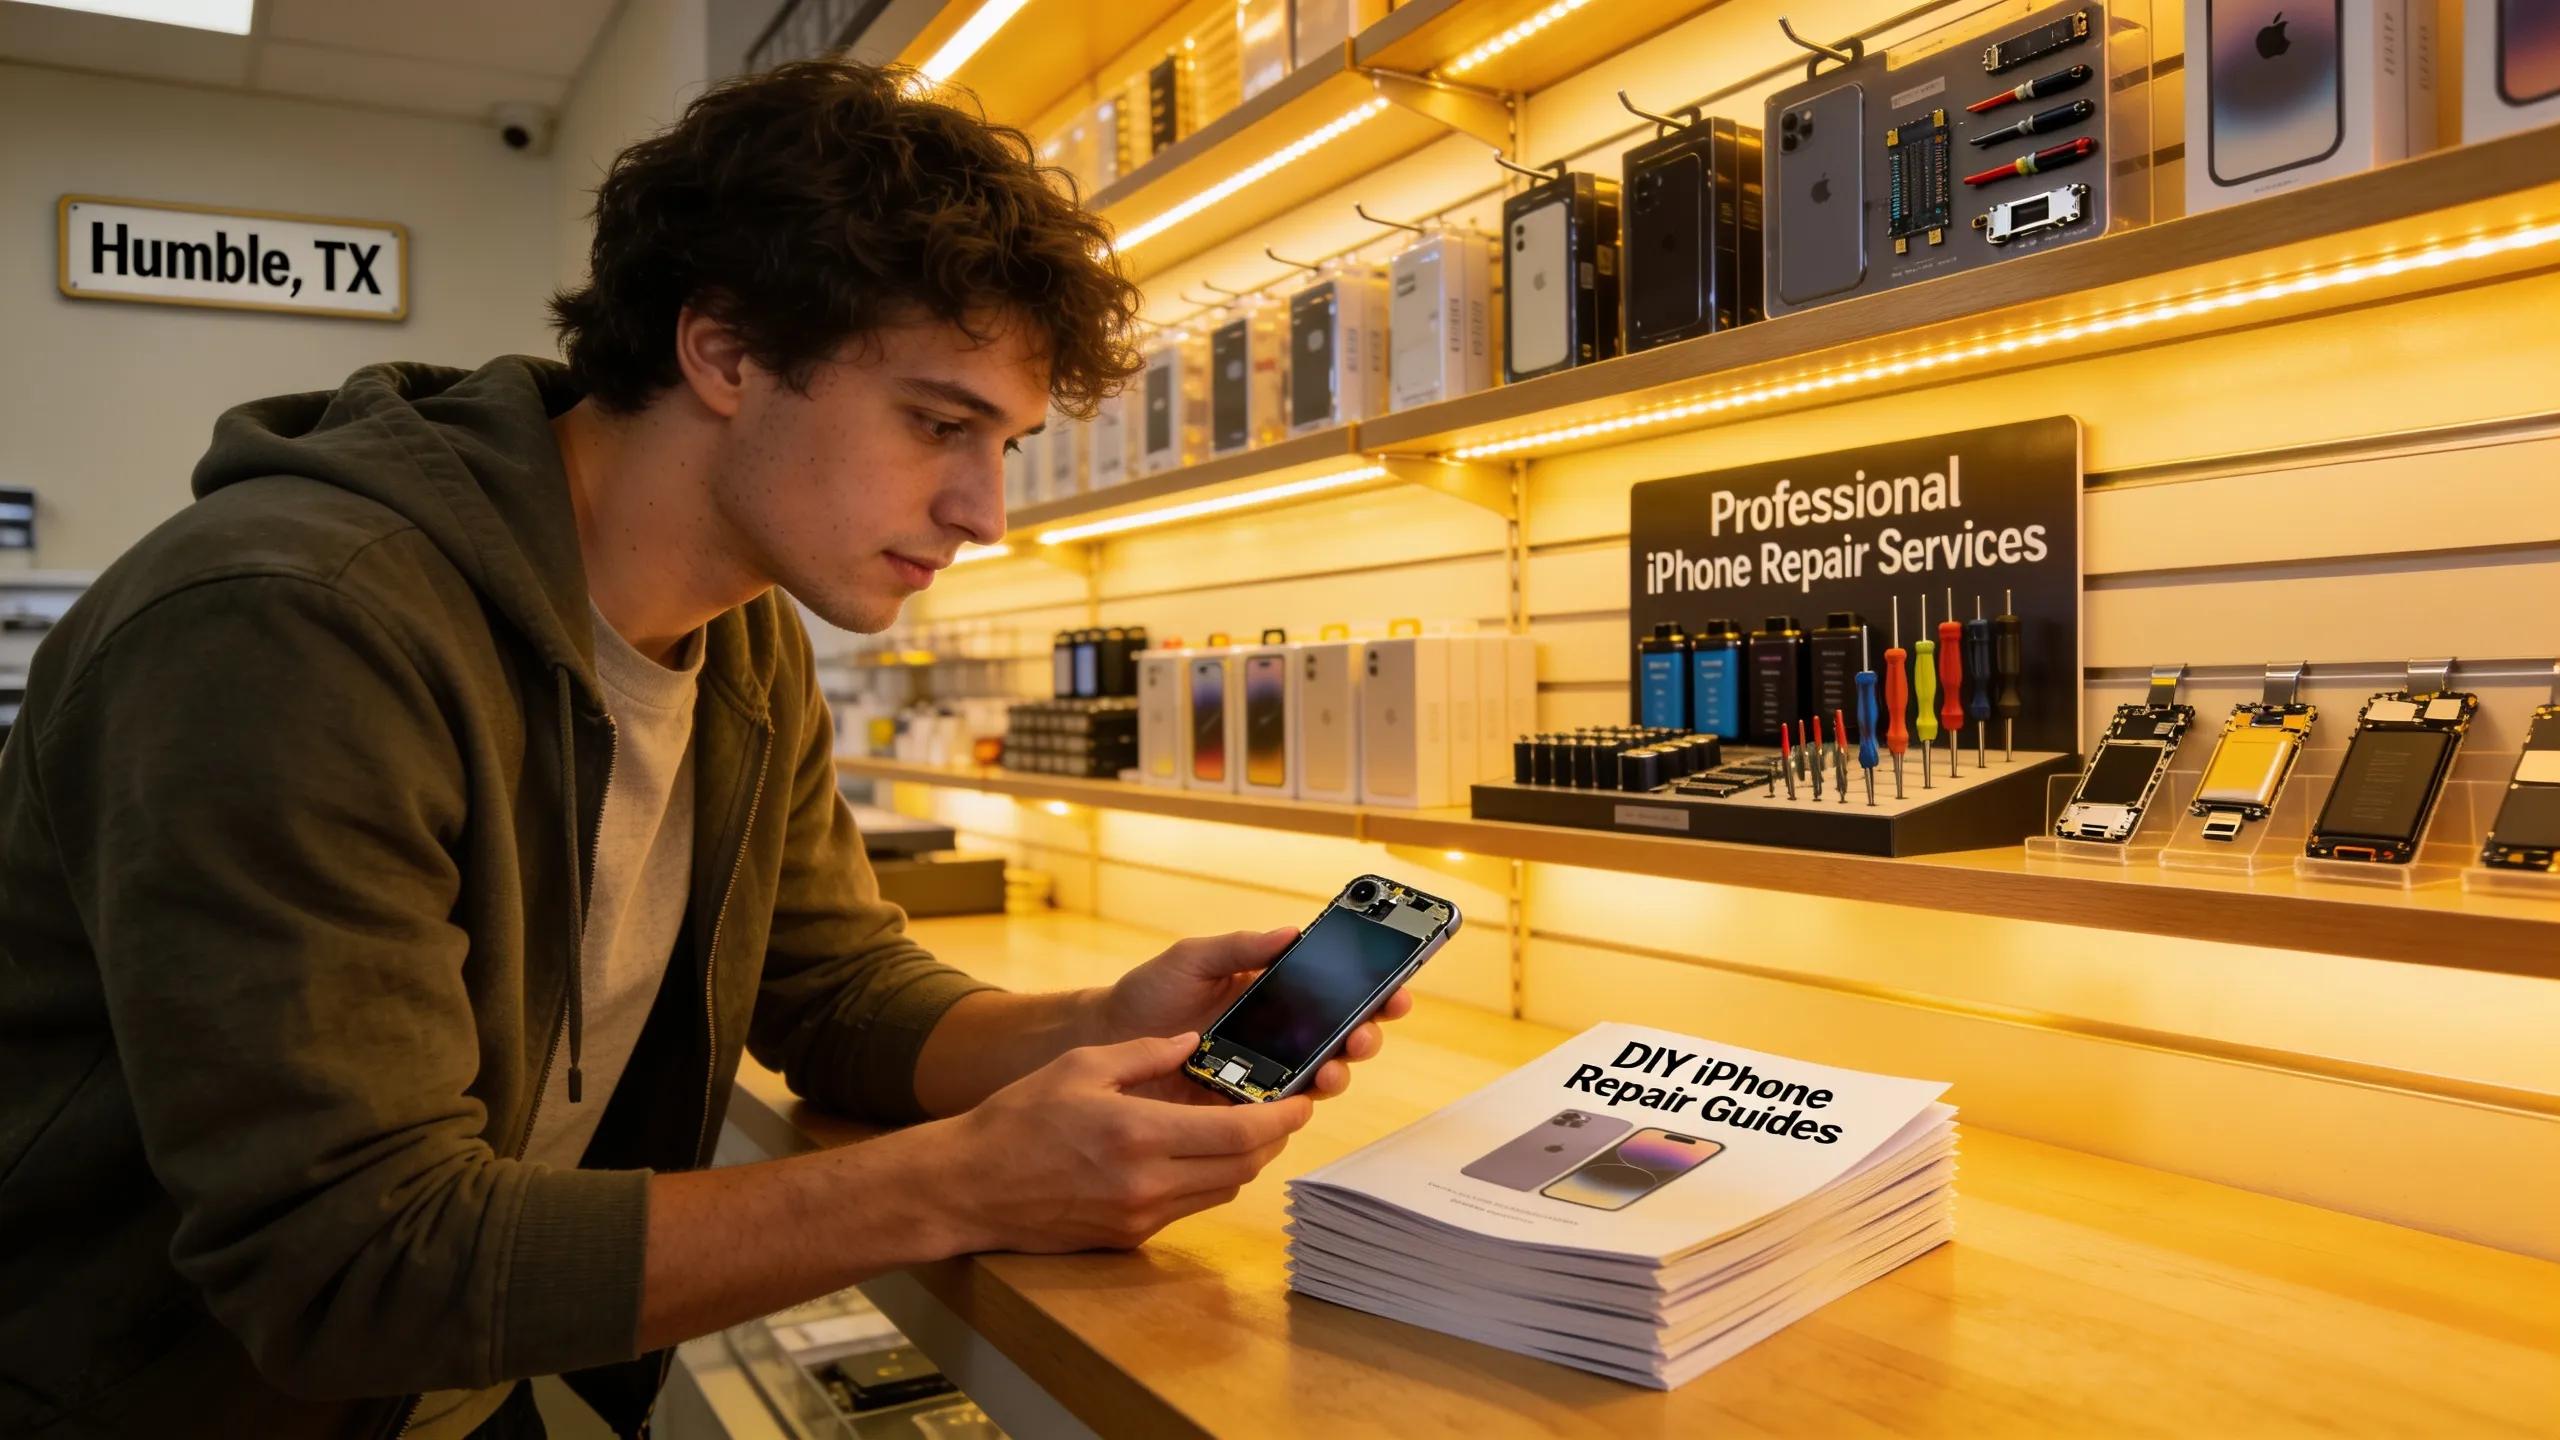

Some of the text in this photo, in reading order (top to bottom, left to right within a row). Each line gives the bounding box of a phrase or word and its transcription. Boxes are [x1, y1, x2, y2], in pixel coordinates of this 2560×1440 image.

[91, 221, 381, 298] Humble, TX
[1710, 454, 1962, 537] Professional
[1646, 519, 2048, 595] iPhone Repair Services
[1563, 1063, 1843, 1145] Repair Guides
[1610, 1041, 1834, 1109] DIY iPhone
